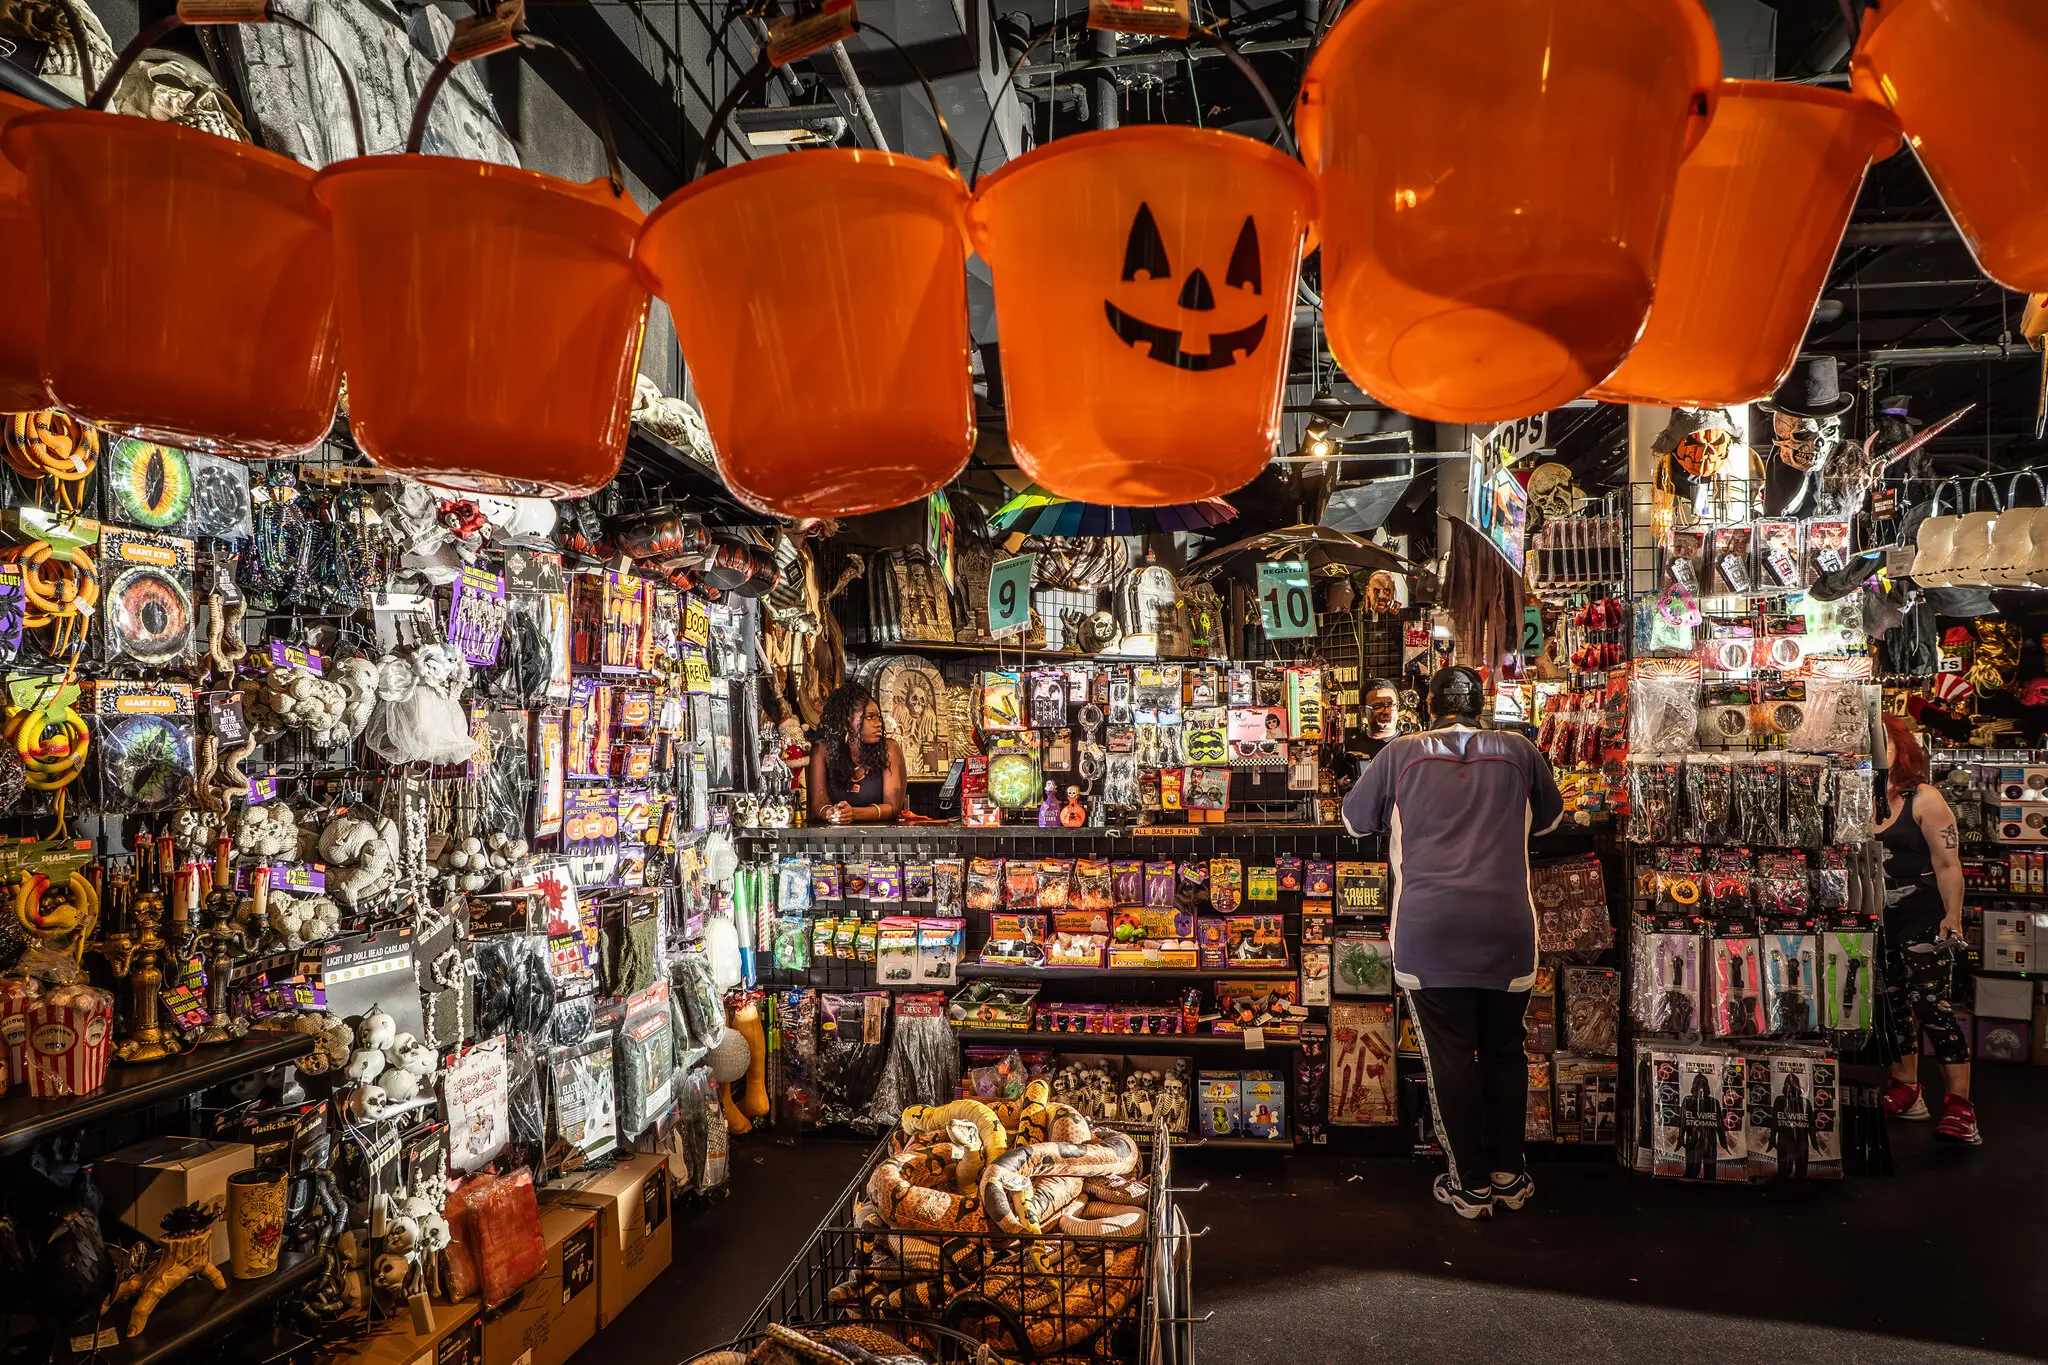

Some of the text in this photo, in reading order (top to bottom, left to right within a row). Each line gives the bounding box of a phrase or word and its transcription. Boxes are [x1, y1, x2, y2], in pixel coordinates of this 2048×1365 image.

[1483, 412, 1544, 477] PROPS
[994, 559, 1030, 572] REGISTER
[1263, 567, 1305, 575] REGISTER
[998, 579, 1016, 619] 9
[1263, 587, 1309, 629] 10
[686, 607, 709, 639] BOO!
[284, 647, 295, 664] 12
[124, 699, 152, 707] GIANT
[41, 853, 71, 863] SNAKE
[285, 869, 297, 884] 12
[1343, 887, 1380, 899] ZOMBIE
[1346, 896, 1378, 906] VIRUS
[882, 930, 915, 939] CREEPY
[921, 929, 956, 946] CREEPY ANTS
[1148, 926, 1170, 939] Skull
[326, 955, 345, 967] LIGHT
[344, 953, 353, 964] UP
[352, 950, 368, 962] DOLL
[368, 947, 384, 959] HEAD
[384, 942, 410, 956] GARLAND
[294, 989, 303, 1004] 12
[903, 1005, 932, 1015] DECOR
[1697, 1112, 1718, 1121] WIRE
[1788, 1112, 1809, 1121] WIRE
[251, 1121, 277, 1135] Plastic
[1685, 1119, 1718, 1128] STICKMAN
[1777, 1119, 1810, 1129] STICKMAN
